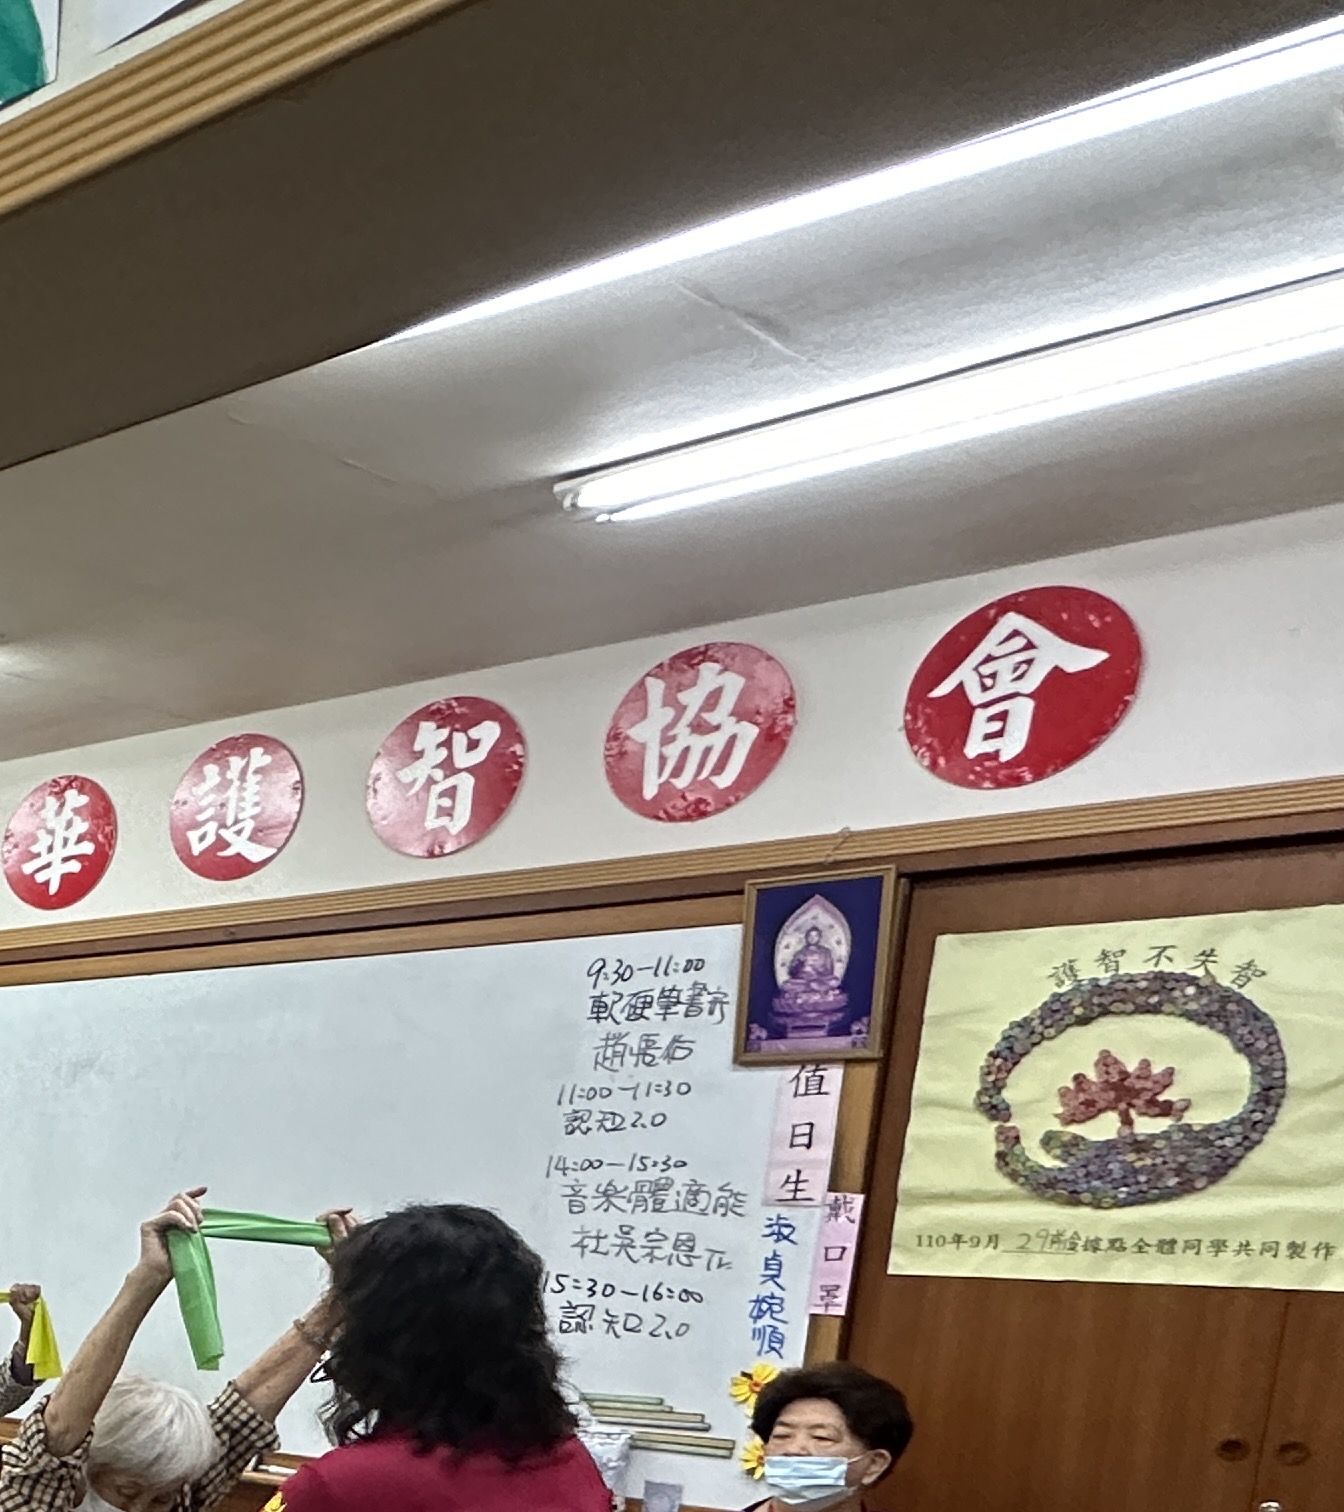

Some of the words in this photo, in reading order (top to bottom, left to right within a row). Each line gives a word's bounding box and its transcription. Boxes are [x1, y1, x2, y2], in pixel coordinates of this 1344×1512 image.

[1047, 944, 1267, 989] 護智不失智
[774, 1063, 830, 1204] 值日生
[813, 1193, 856, 1313] 戴口罩
